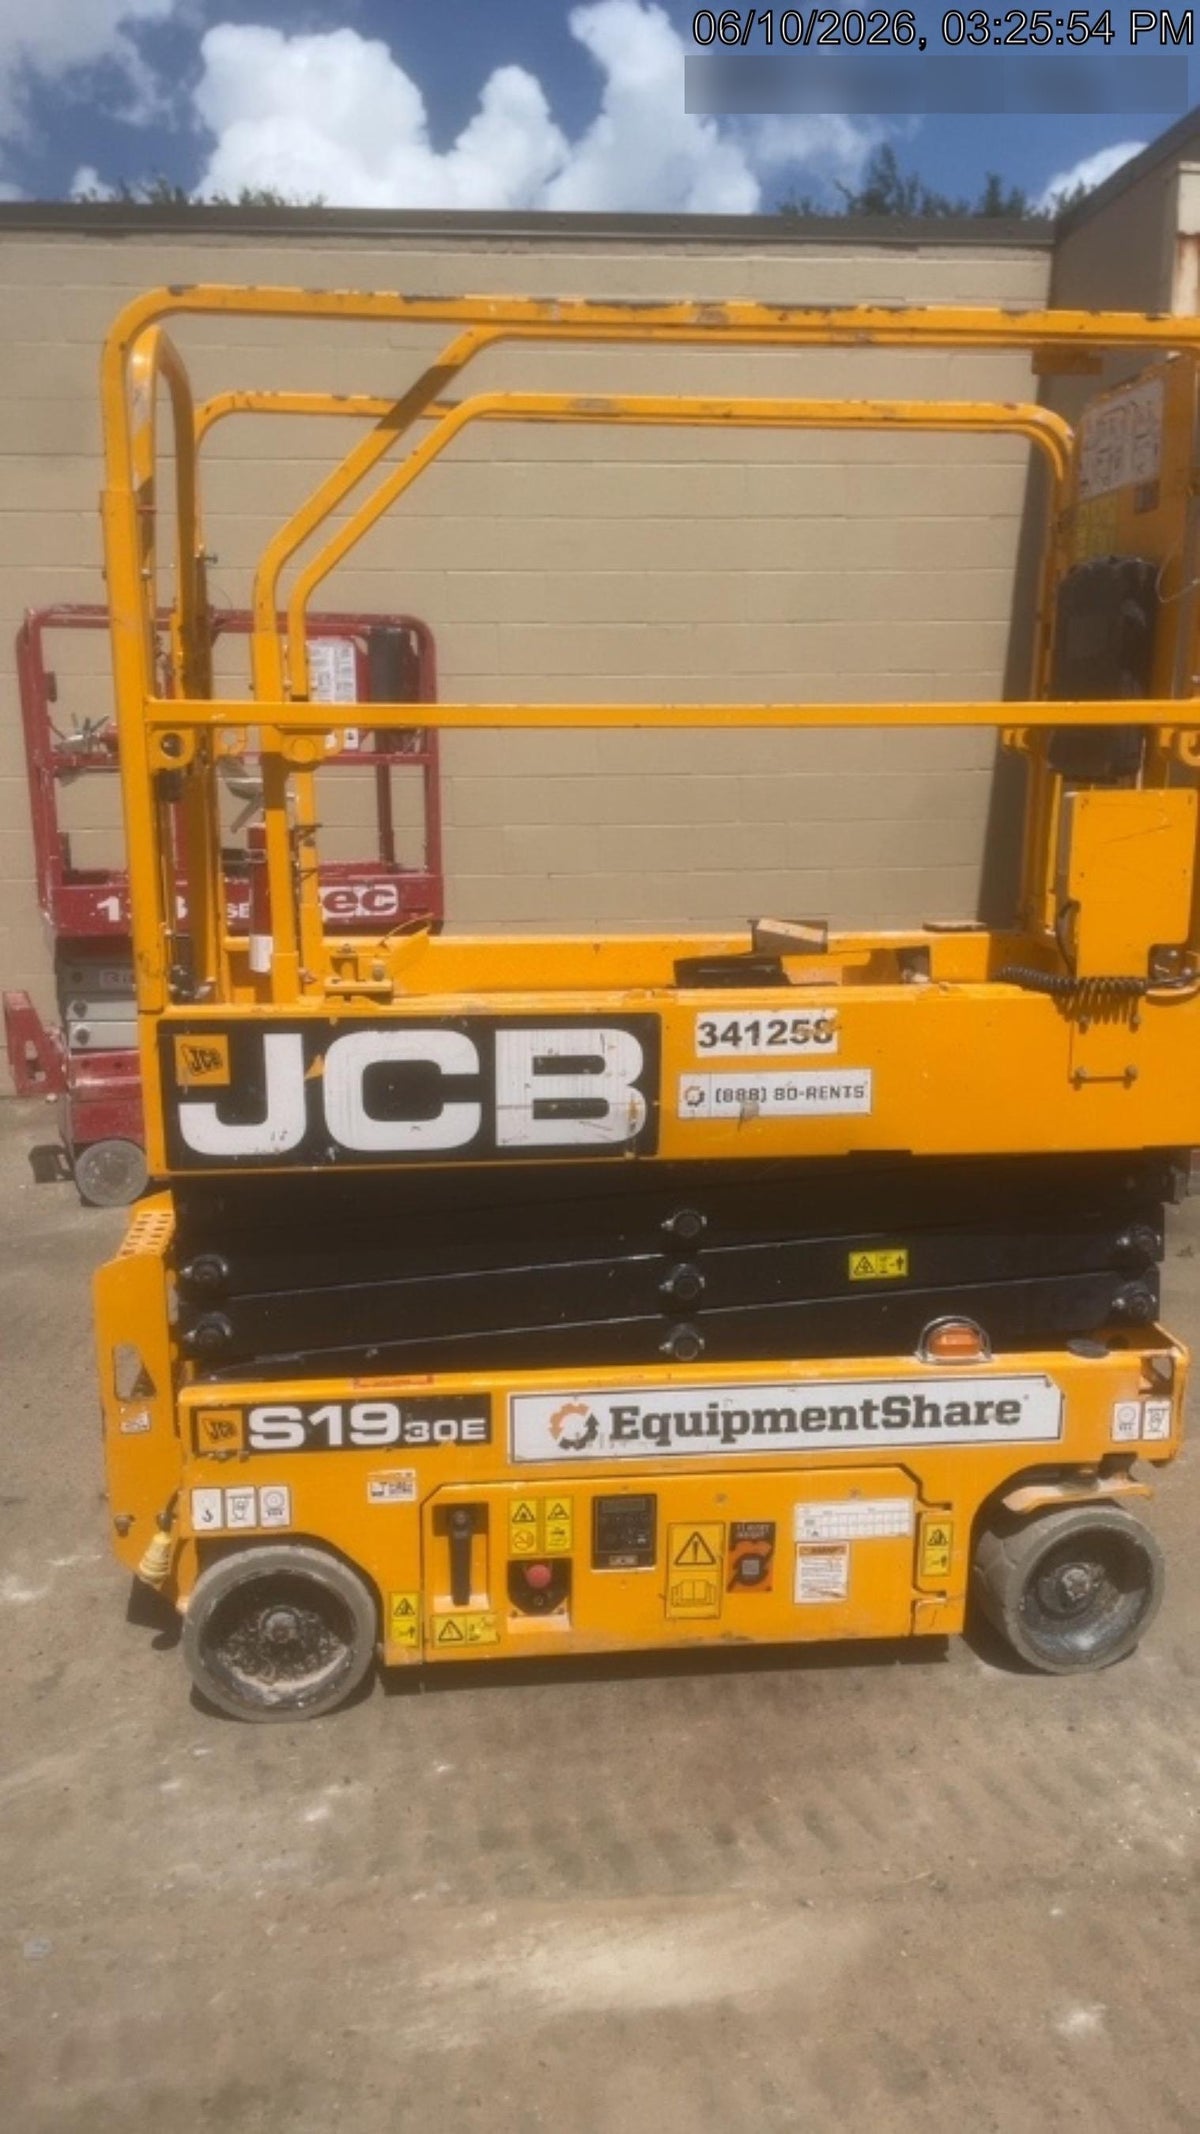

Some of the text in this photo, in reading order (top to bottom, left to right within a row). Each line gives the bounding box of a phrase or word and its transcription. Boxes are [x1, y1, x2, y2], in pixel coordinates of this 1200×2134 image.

[177, 1029, 647, 1156] JCB
[715, 1085, 767, 1103] (888)
[608, 1393, 1022, 1447] EquipmentShare
